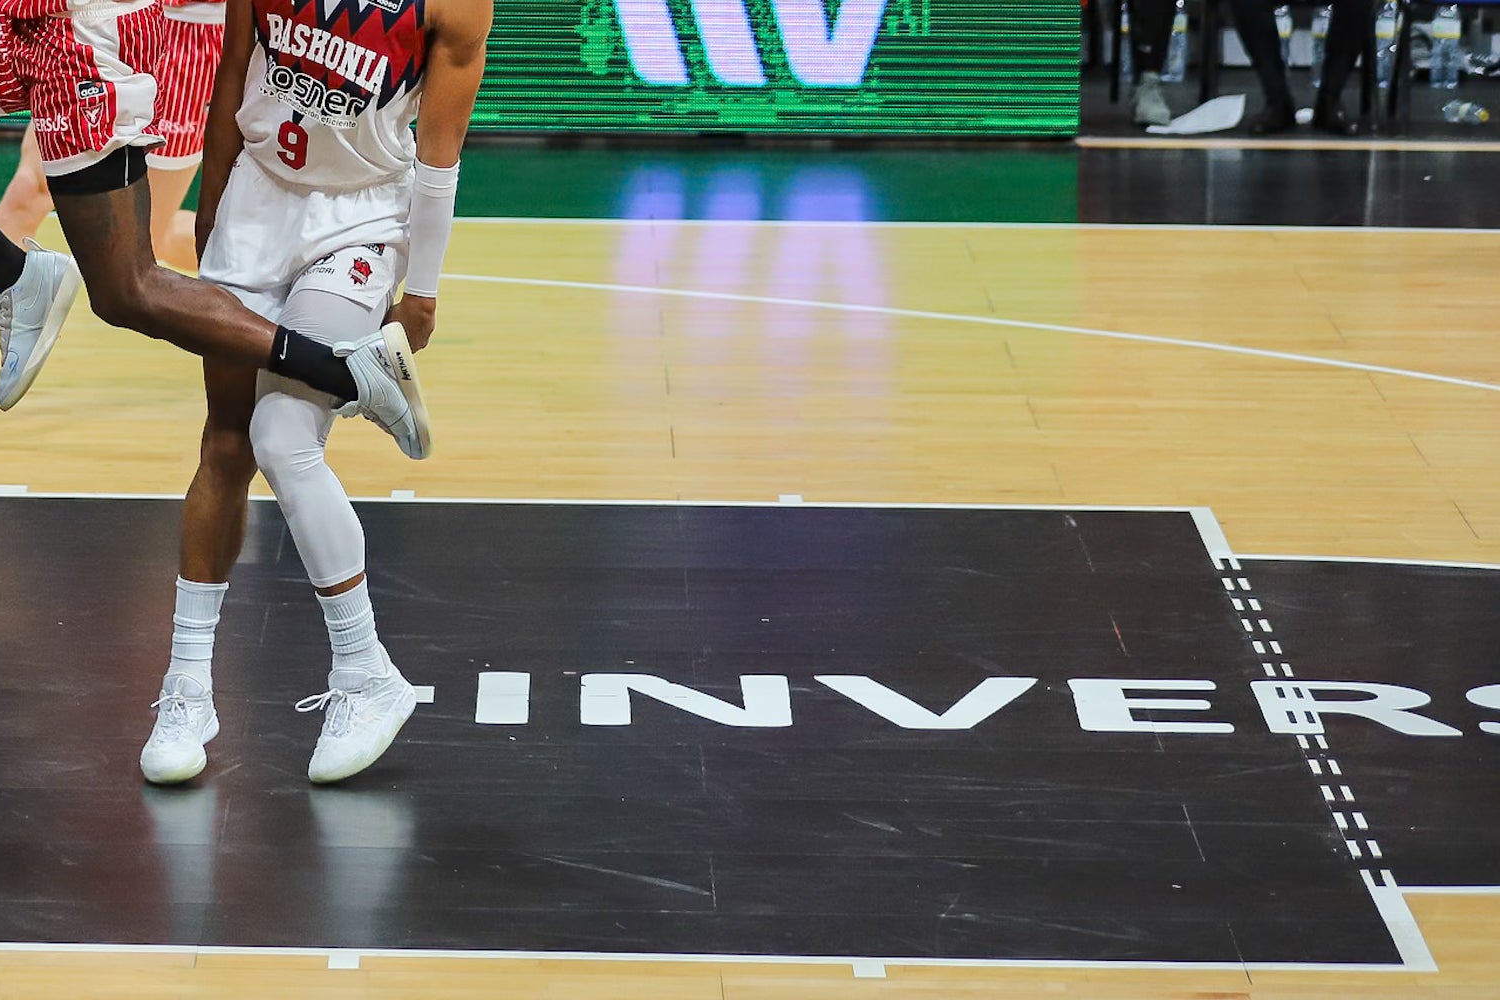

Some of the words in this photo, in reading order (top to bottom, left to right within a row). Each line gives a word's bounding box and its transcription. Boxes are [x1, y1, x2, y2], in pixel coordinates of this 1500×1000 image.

[266, 13, 389, 96] BASKONIA
[80, 85, 100, 97] acb
[33, 112, 69, 133] ERSUS
[277, 120, 308, 171] 9
[476, 671, 1500, 736] INVER
